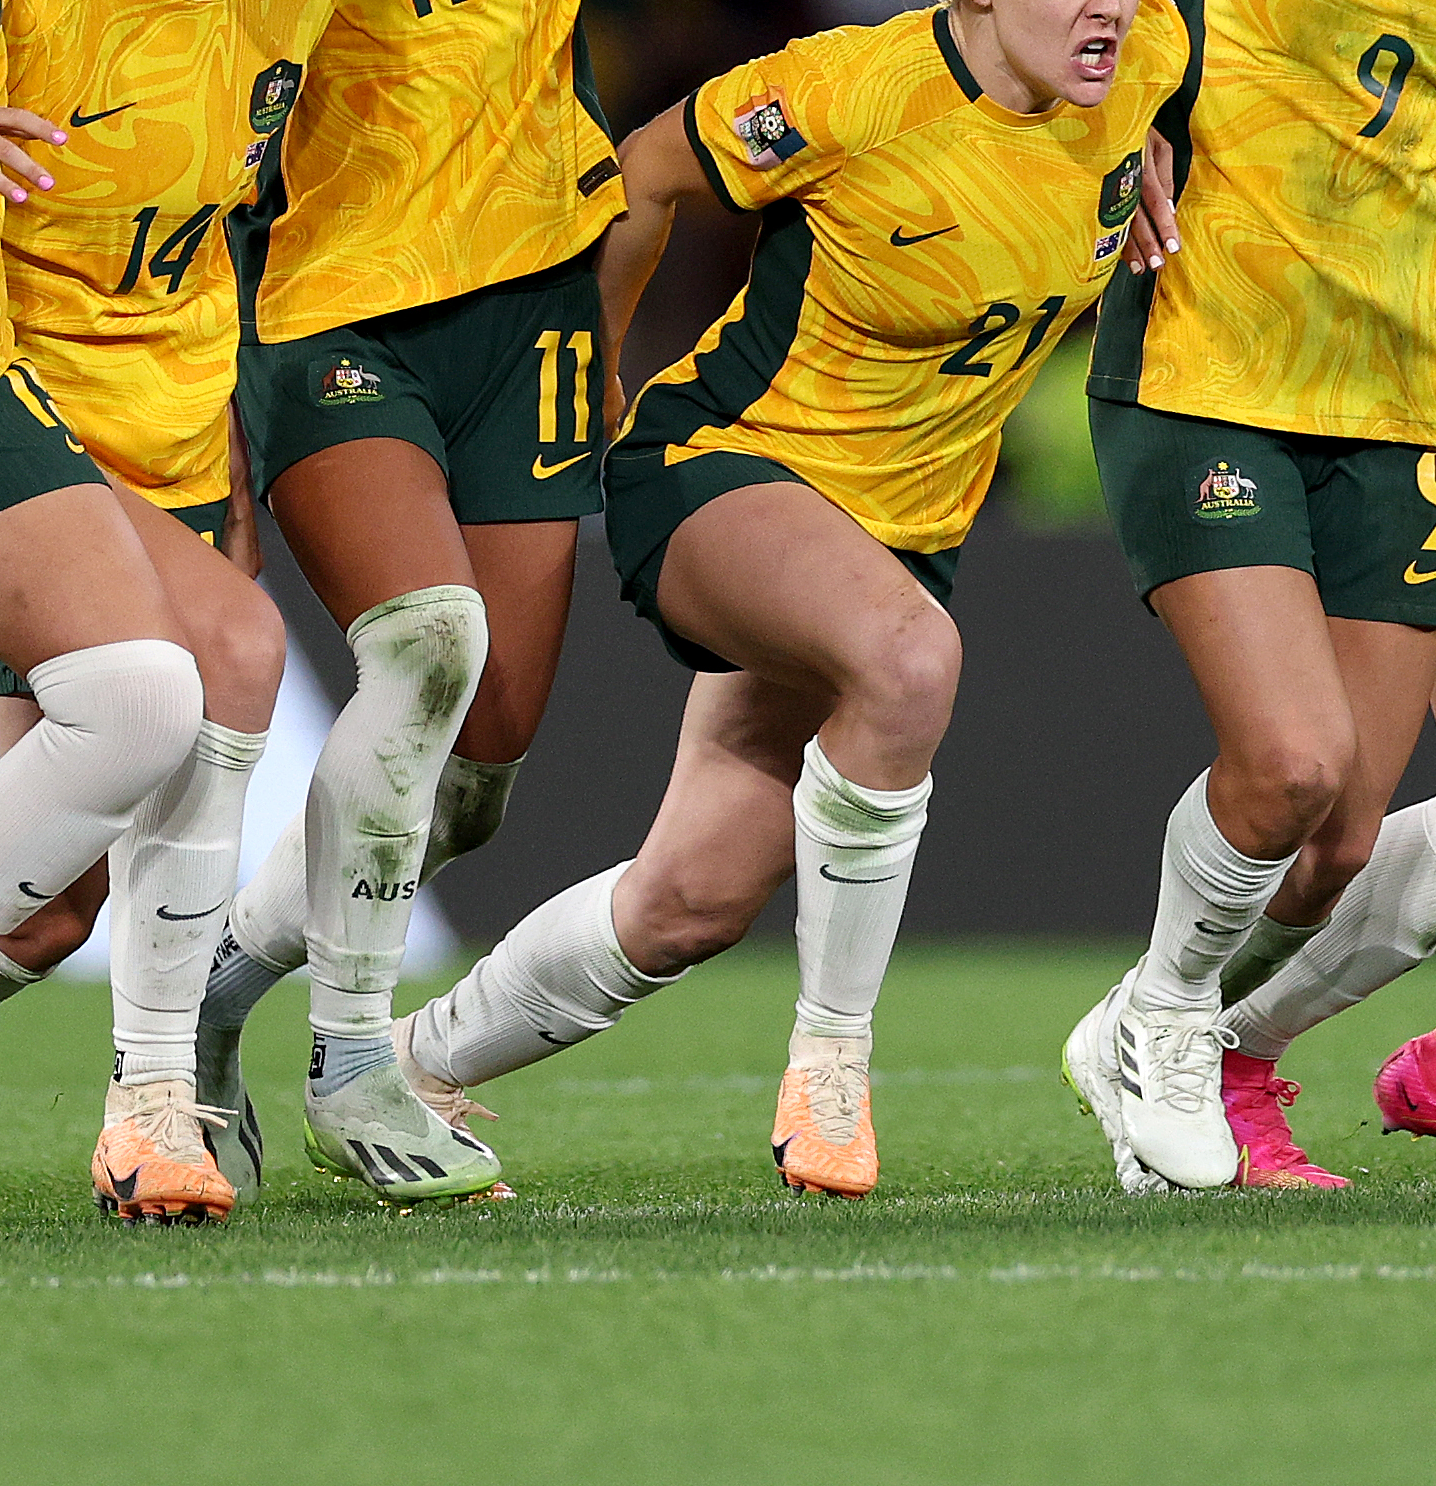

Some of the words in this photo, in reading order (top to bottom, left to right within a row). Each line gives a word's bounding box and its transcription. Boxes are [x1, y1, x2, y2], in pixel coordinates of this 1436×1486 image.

[1355, 35, 1414, 138] 9
[113, 203, 221, 295] 14
[938, 295, 1067, 378] 21
[324, 388, 379, 400] AUSTRALIA
[532, 330, 593, 444] 11
[1200, 498, 1255, 511] AUSTRALIA
[351, 878, 416, 902] AUS
